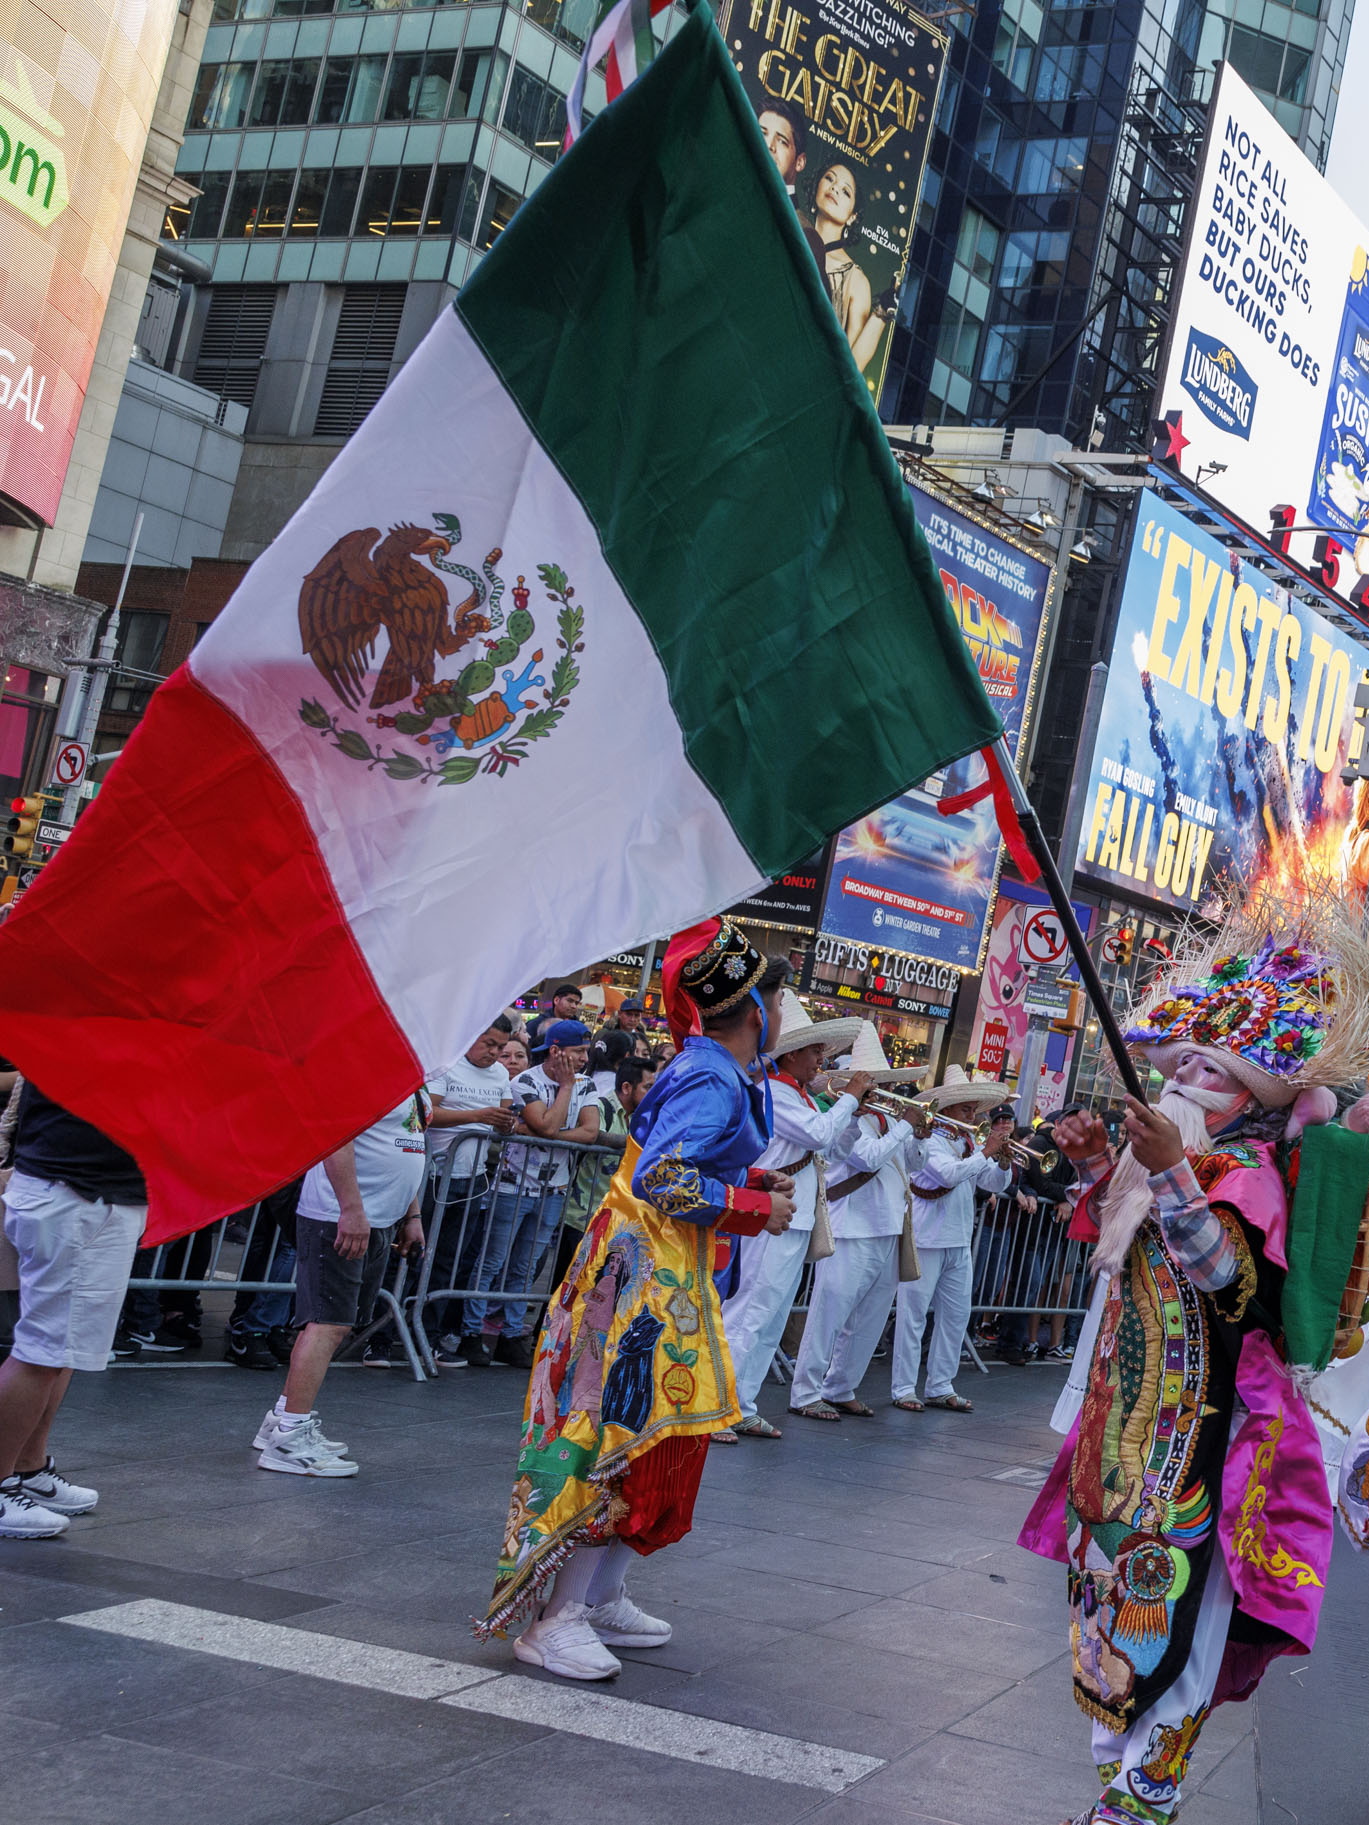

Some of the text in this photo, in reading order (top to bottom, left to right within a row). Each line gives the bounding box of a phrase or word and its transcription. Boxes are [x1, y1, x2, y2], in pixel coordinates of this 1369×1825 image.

[749, 0, 926, 133] THE GREAT
[758, 49, 898, 158] GATSBY
[809, 124, 870, 167] A NEW MUSICAL
[1225, 114, 1287, 207] NOT ALL
[1218, 148, 1309, 265] RICE SAVES
[861, 226, 900, 256] NOBLEZADA
[875, 224, 889, 239] EVA
[1212, 183, 1312, 314] BABY DUCKS,
[1205, 218, 1287, 316] BUT OURS
[1199, 252, 1320, 387] DUCKING DOES
[1185, 343, 1252, 428] LUNDBERG
[1197, 390, 1217, 412] FAMILY
[950, 524, 973, 548] TIME
[973, 537, 987, 556] TO
[987, 545, 1026, 579] CHANGE
[956, 546, 1037, 602] THEATER HISTORY
[1297, 632, 1351, 774] TO
[1101, 757, 1156, 798] RYAN GOSLING
[1174, 791, 1197, 817] EMILY
[42, 827, 62, 839] ONE
[1085, 782, 1215, 902] FALL GUY
[783, 875, 817, 889] ONLY!
[844, 880, 964, 922] BROADWAY BETWEEN 50TH AND 51ST ST
[773, 901, 786, 909] AND
[795, 903, 811, 913] AVES
[884, 913, 941, 939] WINTER GARDEN THEATRE
[814, 938, 960, 993] GIFTS LUGGAGE
[884, 979, 903, 994] NY
[817, 982, 951, 1018] Apple Nikon Canon SONY BOWER
[1028, 989, 1044, 998] Times
[984, 1032, 1005, 1047] MINI
